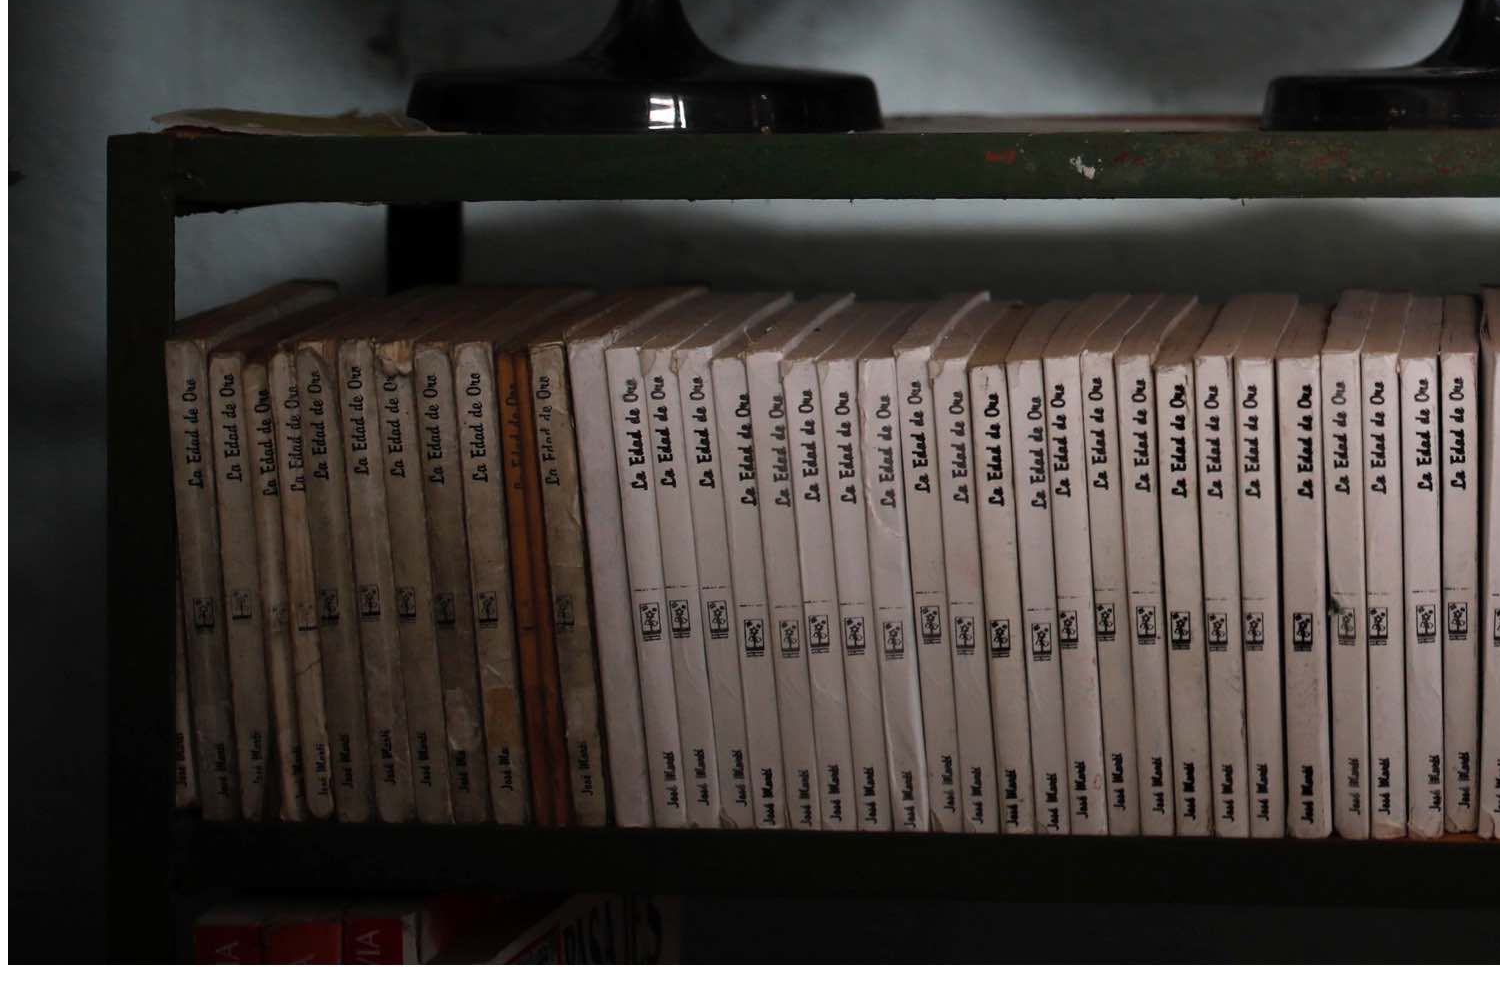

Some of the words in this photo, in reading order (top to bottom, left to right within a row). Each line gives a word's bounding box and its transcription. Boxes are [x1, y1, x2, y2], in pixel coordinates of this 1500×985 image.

[182, 378, 197, 402] Oro
[690, 377, 704, 400] Oro
[1088, 376, 1103, 401] Oro
[1296, 385, 1311, 409] Oro
[183, 408, 198, 423] de
[693, 407, 707, 422] de
[1089, 407, 1104, 423] de
[1297, 415, 1311, 431] de
[184, 430, 201, 464] Edad
[694, 428, 711, 463] Edad
[1090, 430, 1107, 464] Edad
[1297, 437, 1312, 473] Edad
[188, 471, 203, 489] La
[699, 469, 715, 488] La
[1093, 471, 1108, 490] La
[1298, 479, 1313, 499] La
